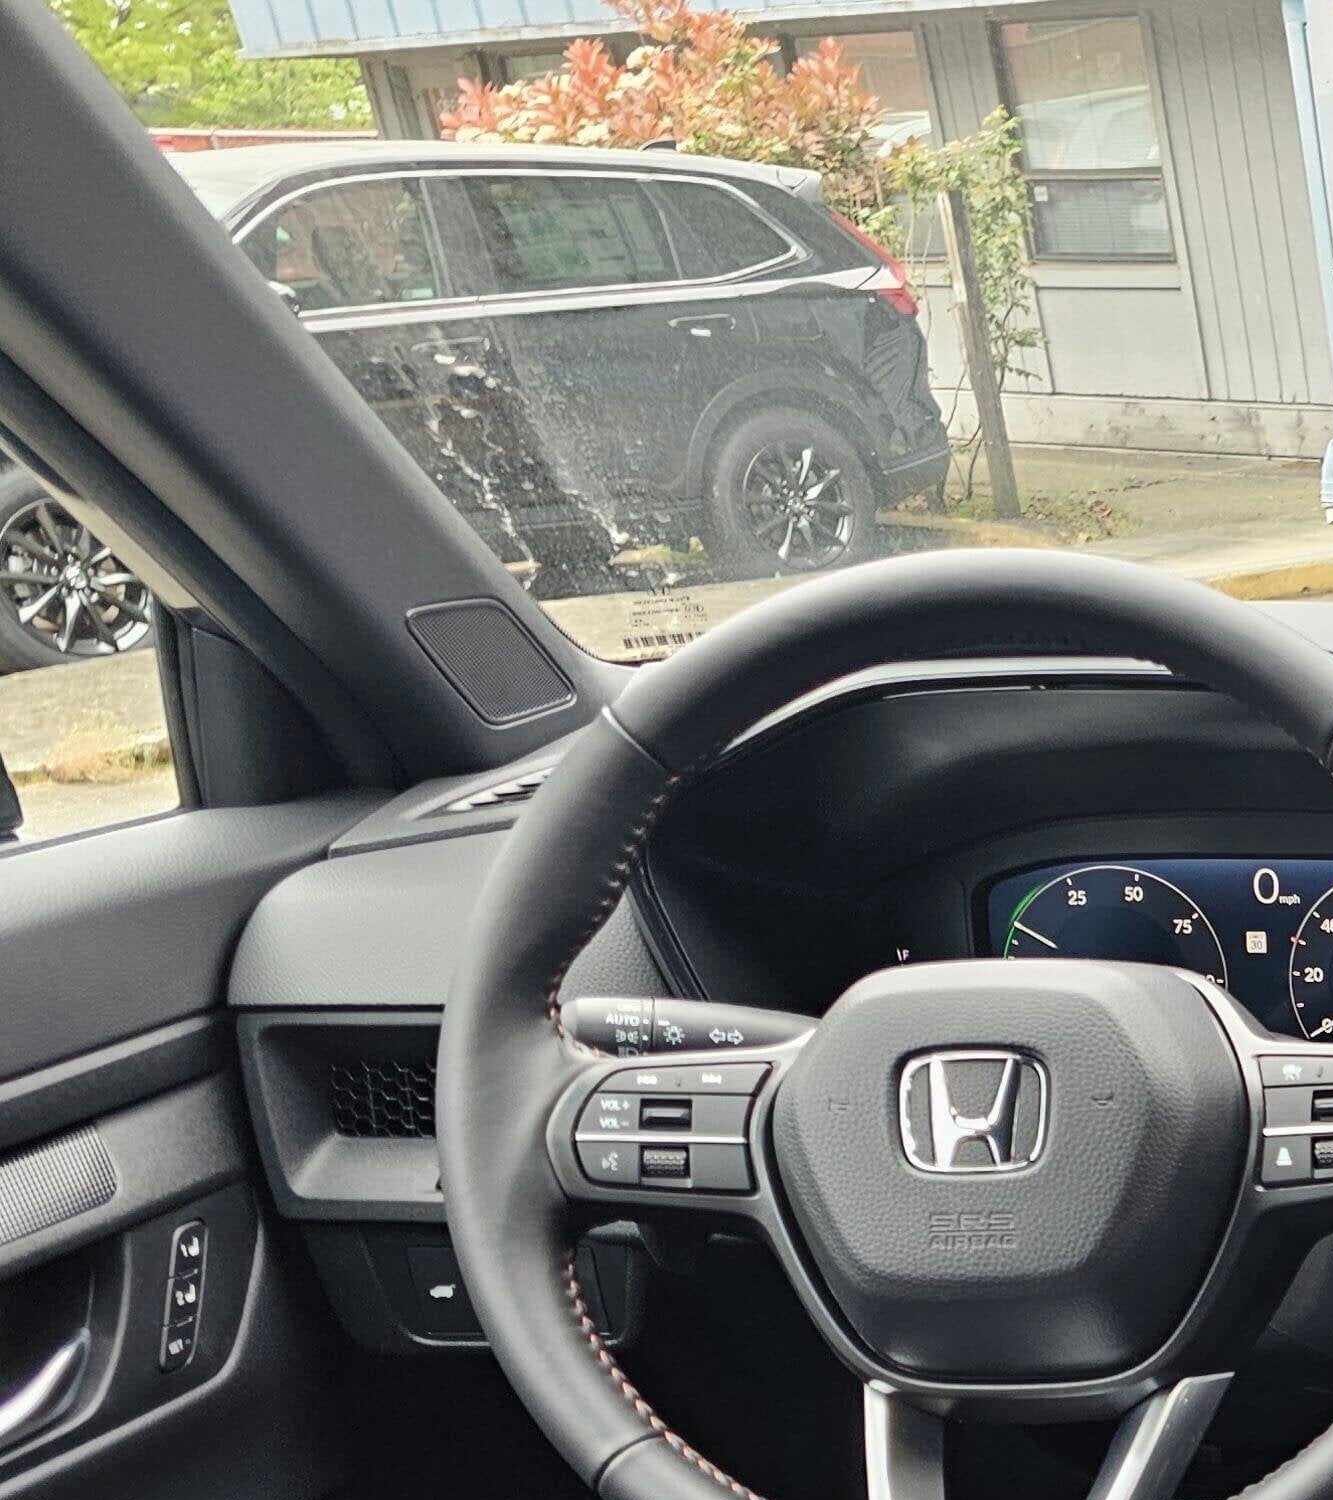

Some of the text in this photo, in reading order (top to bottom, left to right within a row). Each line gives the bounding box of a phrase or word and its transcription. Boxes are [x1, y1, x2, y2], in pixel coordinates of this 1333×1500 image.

[1124, 886, 1144, 902] 50
[1253, 867, 1301, 906] 0 mph
[1067, 890, 1087, 906] 25
[1173, 918, 1193, 935] 75
[1251, 941, 1263, 950] 30
[1304, 967, 1324, 983] 20
[605, 1014, 639, 1026] AUTO
[600, 1099, 620, 1111] VOL
[600, 1118, 620, 1129] VOL
